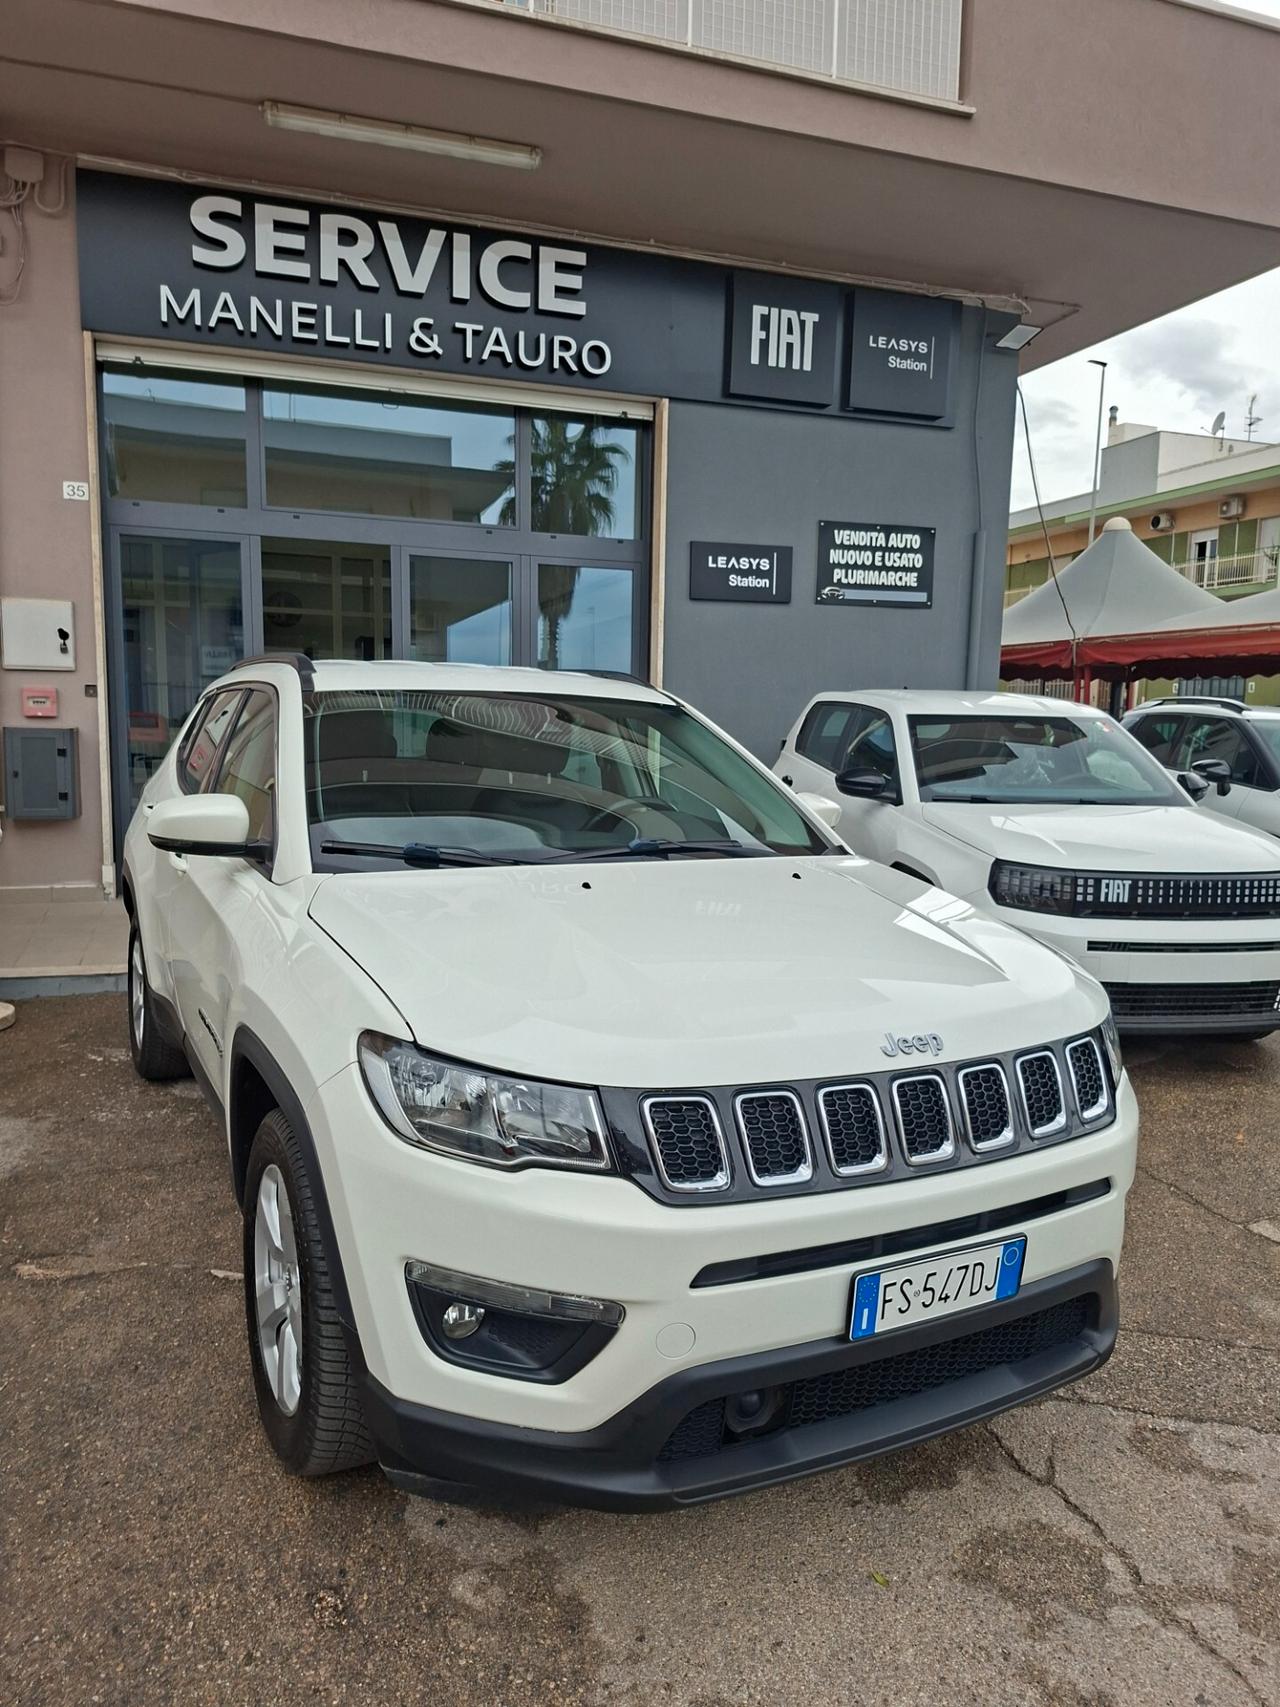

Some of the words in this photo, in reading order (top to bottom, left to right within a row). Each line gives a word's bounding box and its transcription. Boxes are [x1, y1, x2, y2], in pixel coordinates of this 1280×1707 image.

[189, 195, 588, 318] SERVICE
[159, 284, 392, 350] MANELLI
[408, 316, 445, 358] &
[453, 320, 613, 376] TAURO
[750, 304, 820, 372] FIAT
[868, 334, 929, 354] LEASYS
[887, 354, 928, 373] Station
[66, 483, 86, 498] 35
[833, 528, 886, 548] VENDITA
[887, 531, 921, 550] AUTO
[707, 554, 771, 571] LEASYS
[829, 548, 873, 567] NUOVO
[874, 549, 882, 567] E
[884, 551, 923, 569] USATO
[728, 573, 770, 589] Station
[832, 567, 919, 588] PLURIMARCHE
[1100, 878, 1132, 904] FIAT
[880, 1031, 945, 1058] Jeep
